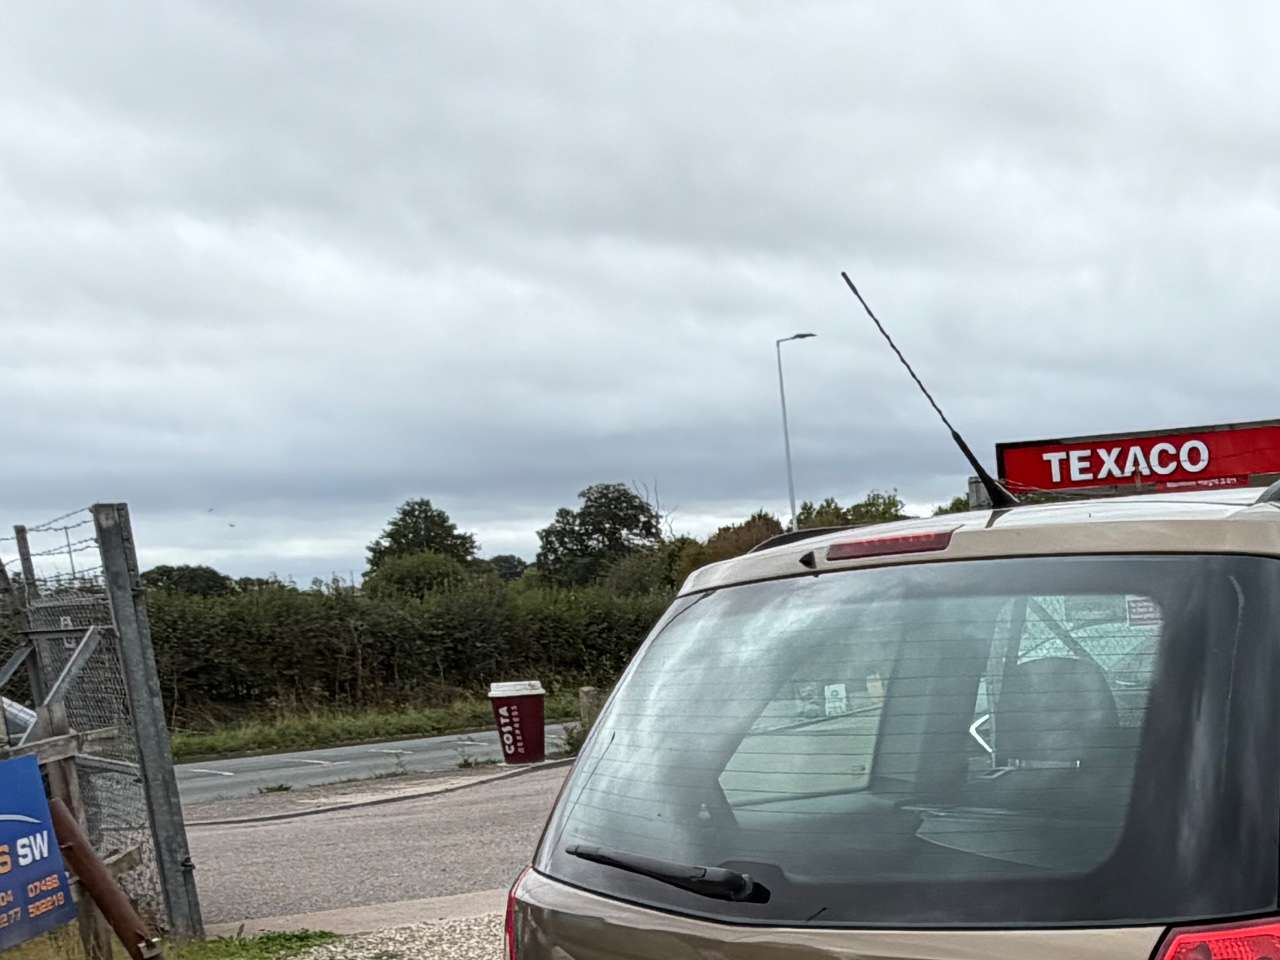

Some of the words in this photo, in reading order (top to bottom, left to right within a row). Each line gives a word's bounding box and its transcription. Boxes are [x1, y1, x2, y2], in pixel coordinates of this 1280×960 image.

[1043, 439, 1209, 483] TEXACO
[498, 706, 515, 753] COSTA
[17, 830, 48, 867] SW
